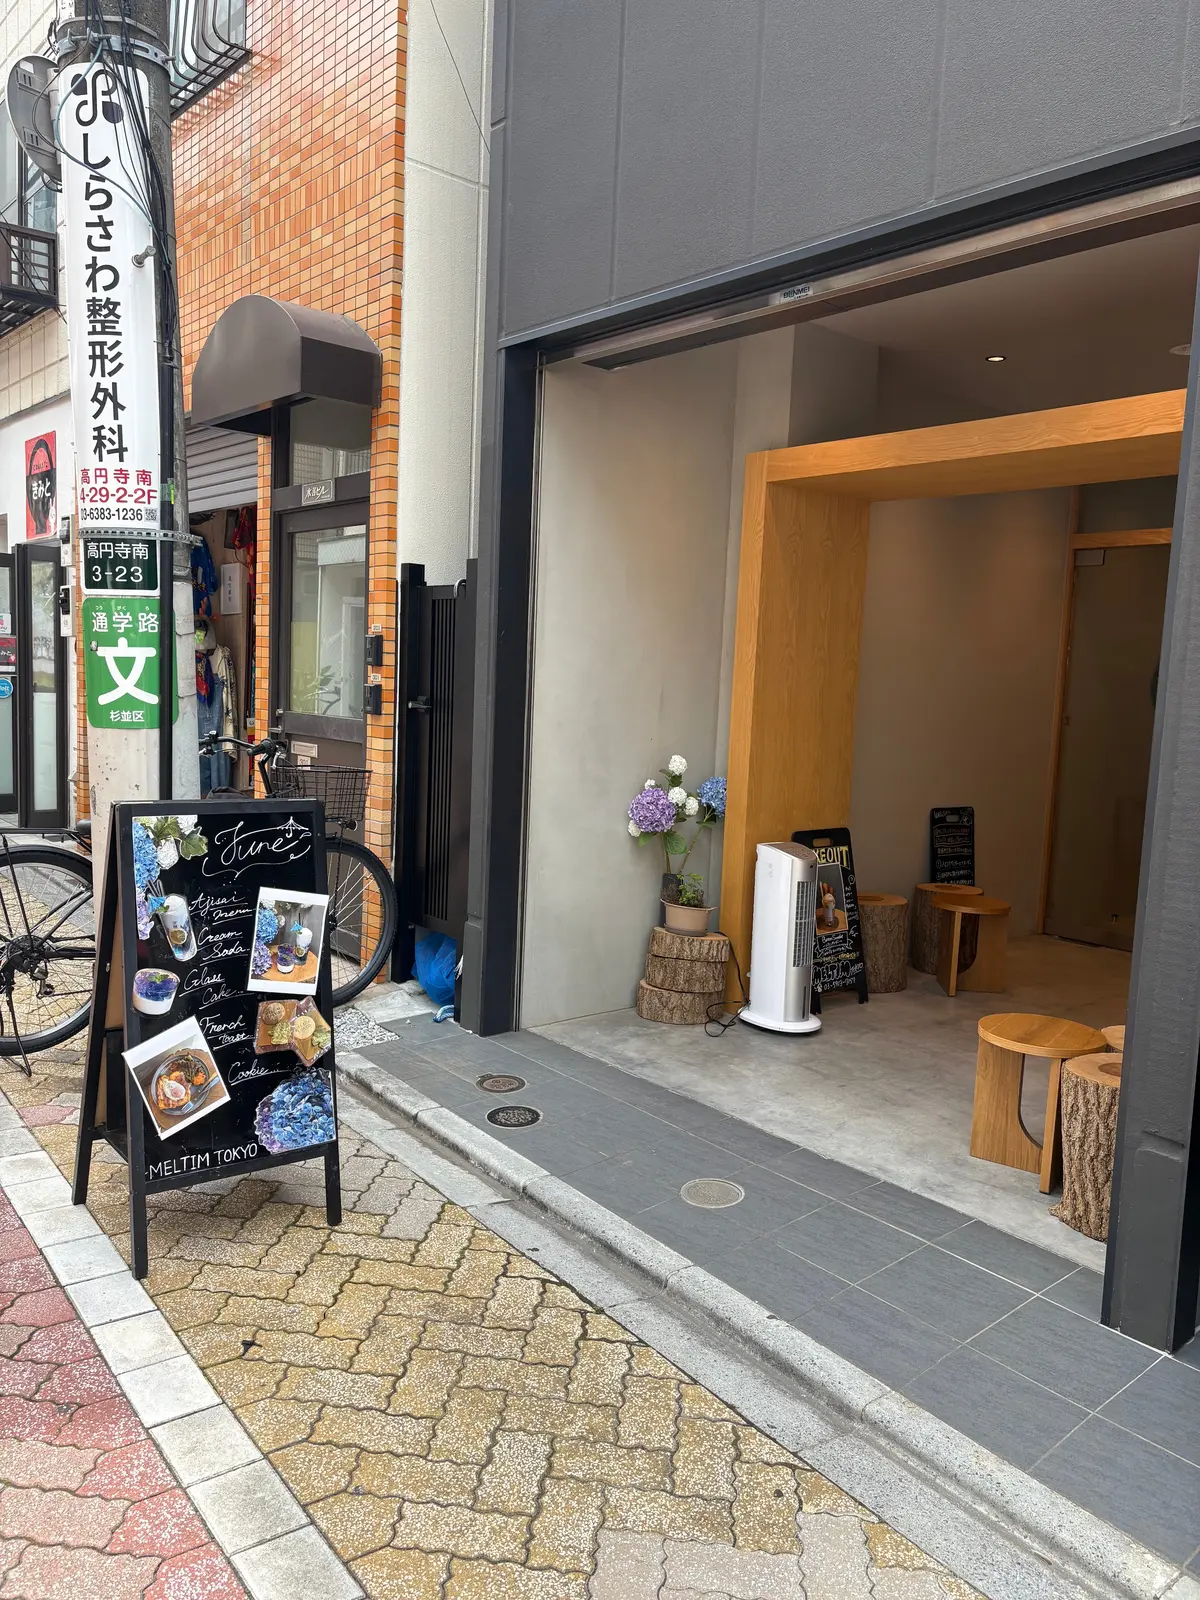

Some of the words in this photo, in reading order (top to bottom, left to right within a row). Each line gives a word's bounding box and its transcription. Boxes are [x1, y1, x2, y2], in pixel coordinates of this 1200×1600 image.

[83, 133, 128, 463] しらさわ整形外科
[80, 467, 152, 486] 高円寺南
[31, 478, 51, 500] きみと
[80, 486, 158, 505] 4-29-2-2F
[87, 541, 149, 559] 高円寺南
[92, 565, 143, 582] 3-23
[91, 611, 160, 633] 通学路
[110, 710, 145, 722] 杉並区
[215, 820, 312, 866] June
[189, 891, 245, 916] Ajisai
[197, 927, 243, 946] Cream
[184, 968, 224, 991] Glass
[200, 1013, 245, 1035] French
[213, 1143, 257, 1165] TOKYO
